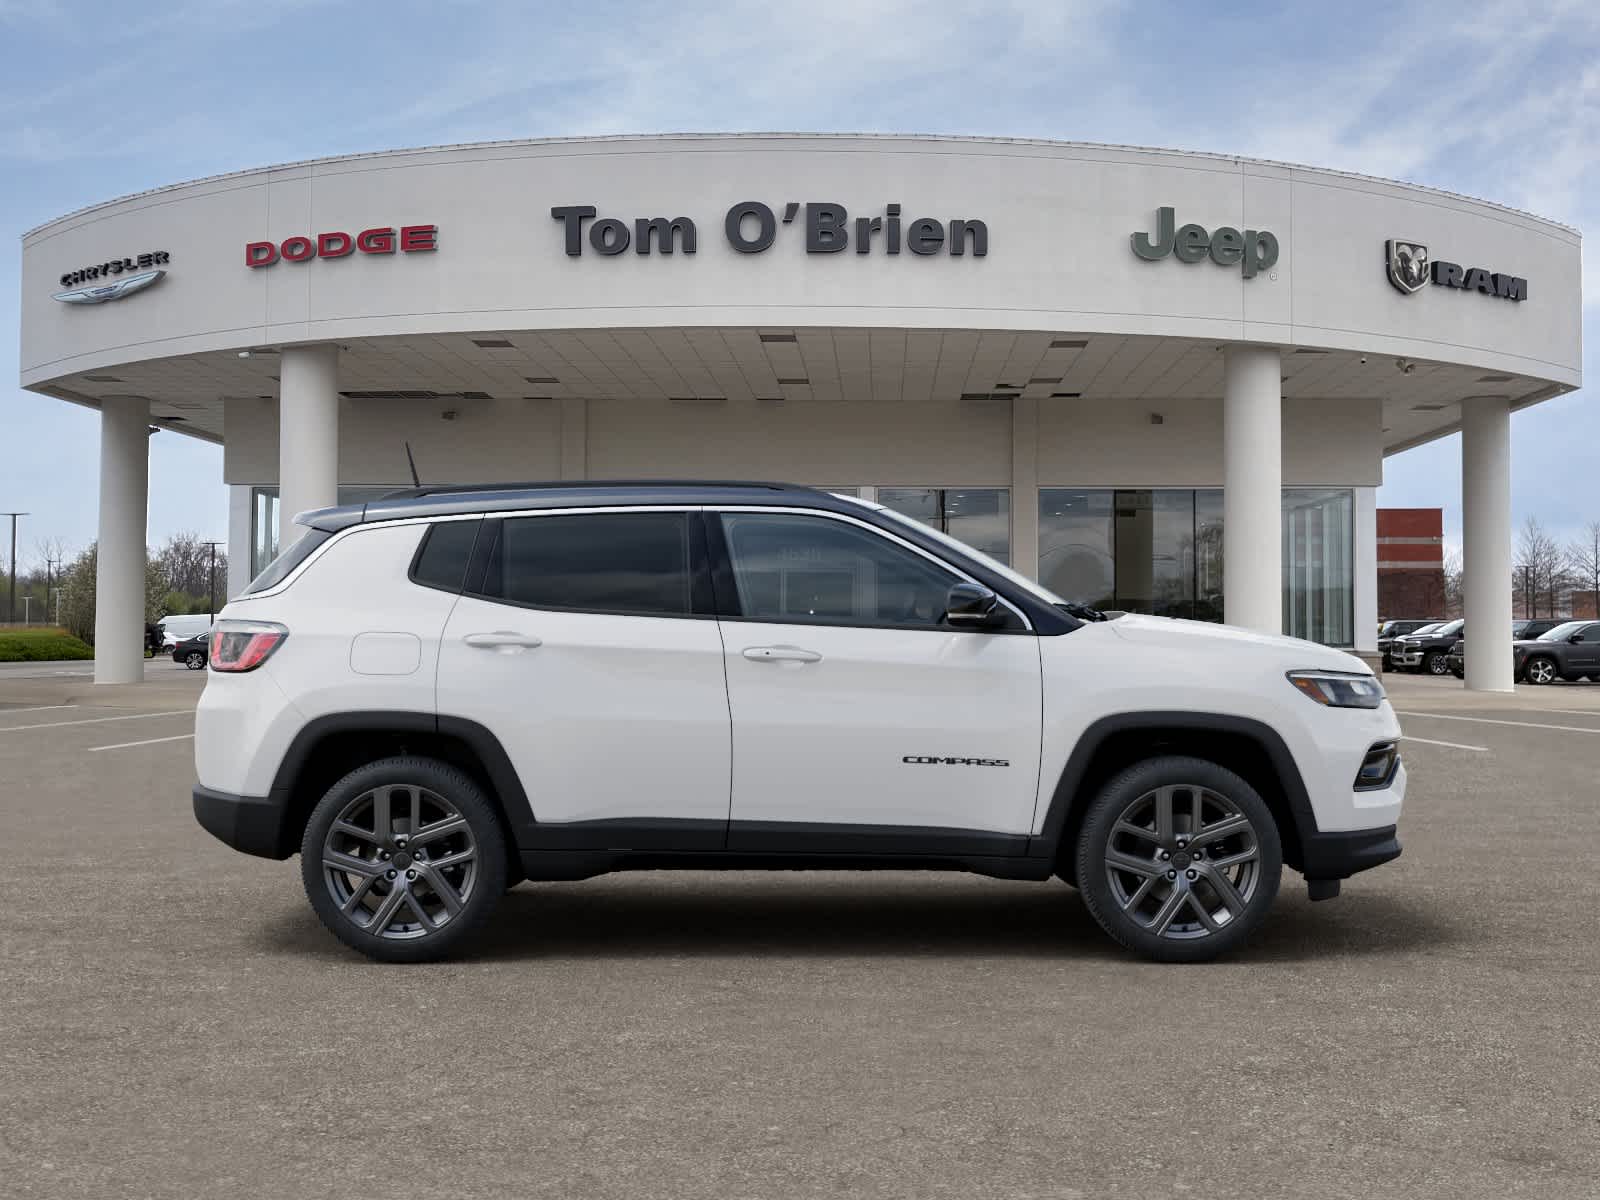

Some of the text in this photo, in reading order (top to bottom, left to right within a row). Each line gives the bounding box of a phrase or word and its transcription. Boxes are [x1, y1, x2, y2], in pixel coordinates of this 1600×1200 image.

[246, 224, 438, 268] DODGE
[551, 201, 989, 257] Tom O'Brien
[1131, 206, 1279, 279] Jeep
[60, 250, 169, 287] CHRYSLER
[1431, 260, 1528, 302] RAM
[902, 756, 1010, 767] COMPASS
